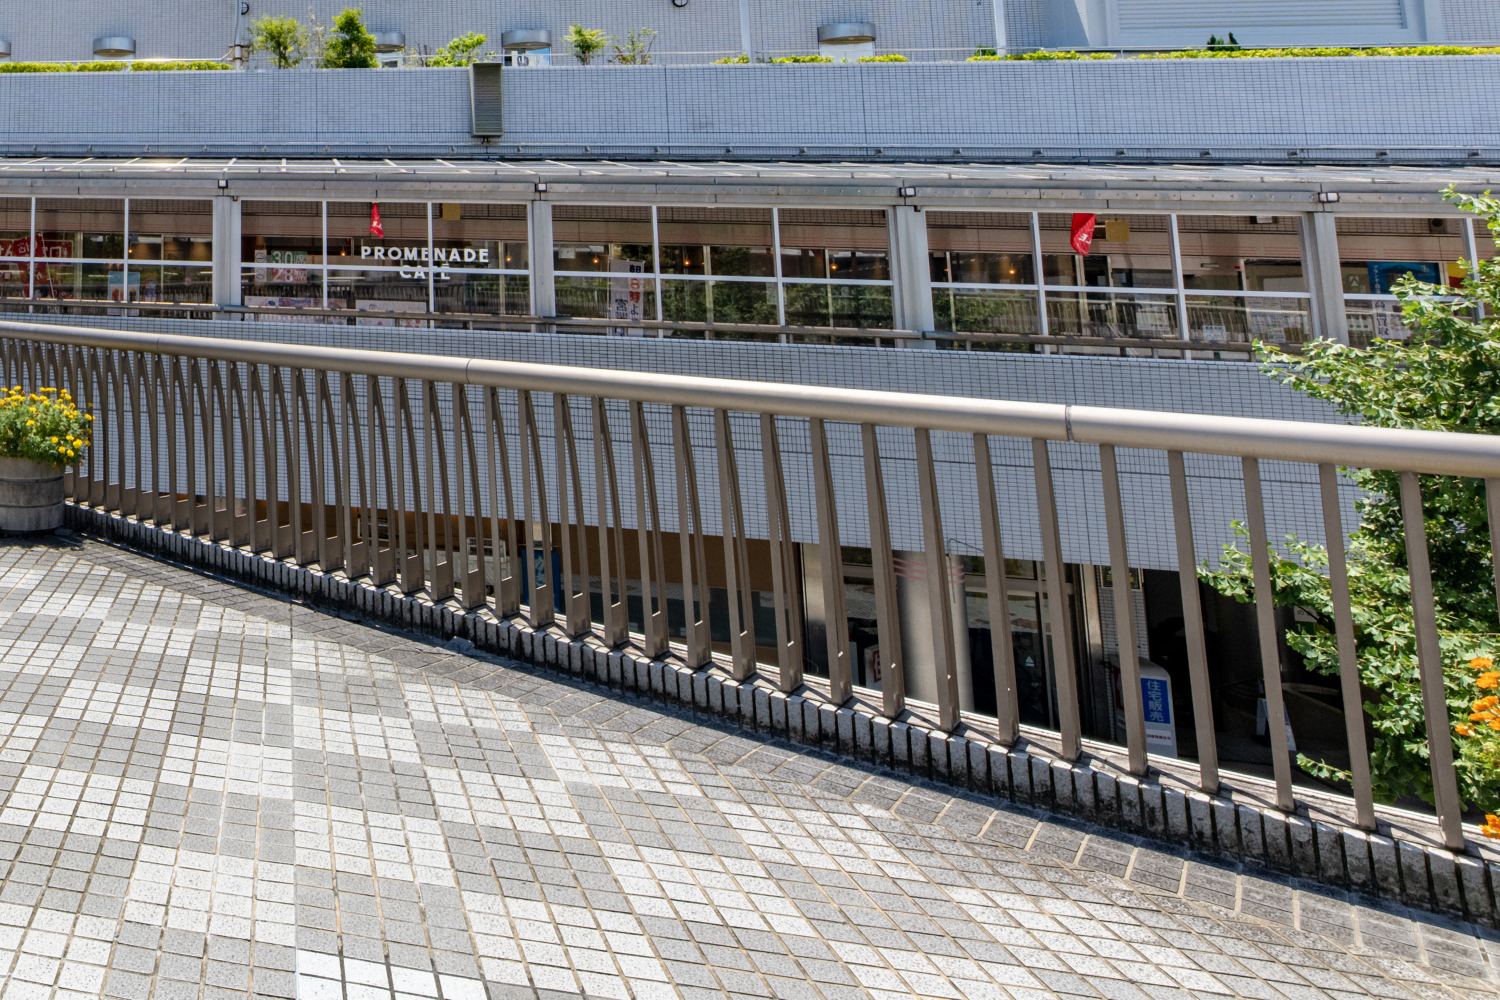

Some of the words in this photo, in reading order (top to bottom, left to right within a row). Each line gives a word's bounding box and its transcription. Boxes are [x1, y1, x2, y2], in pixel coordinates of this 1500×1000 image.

[361, 246, 489, 263] PROMENADE
[1146, 679, 1165, 723] 住宅販売
